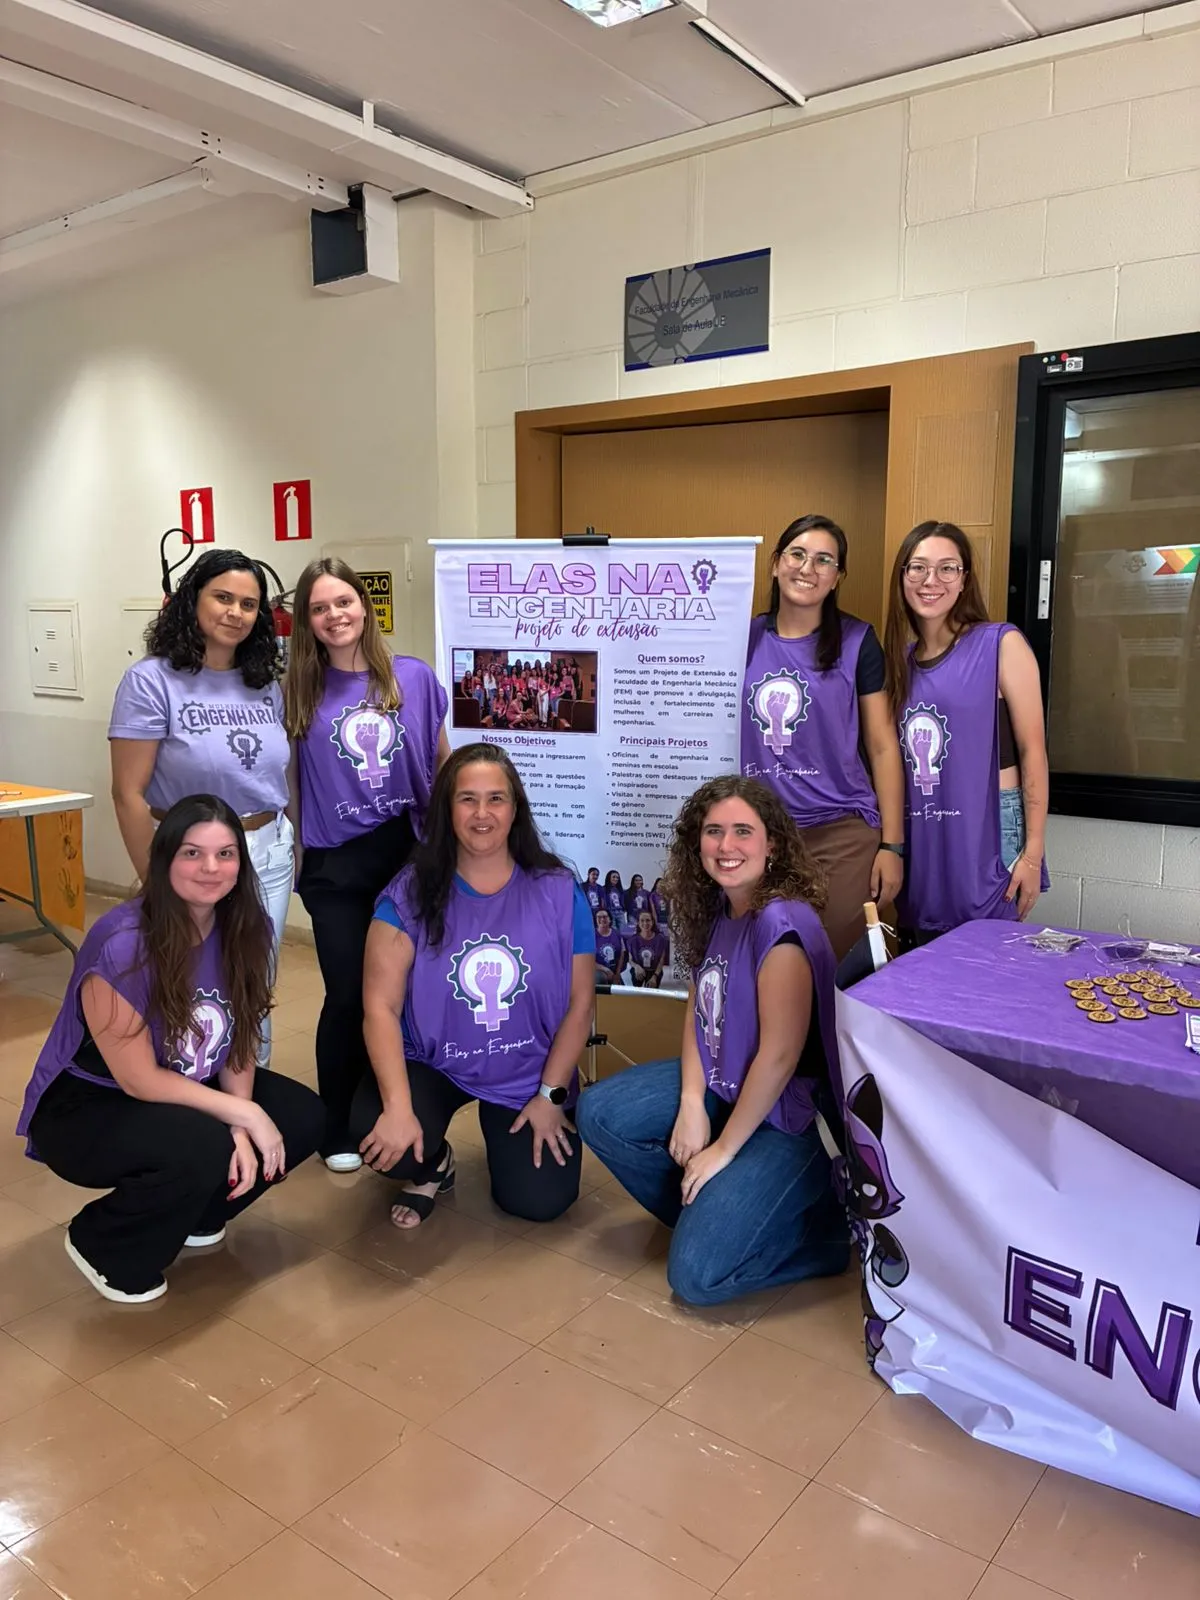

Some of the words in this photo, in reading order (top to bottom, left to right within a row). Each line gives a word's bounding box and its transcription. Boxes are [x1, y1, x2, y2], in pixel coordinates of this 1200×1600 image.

[635, 302, 669, 315] Faculdade
[671, 299, 679, 308] de
[681, 293, 721, 308] Engenharia
[663, 324, 679, 336] Sala
[682, 323, 692, 332] de
[694, 318, 712, 330] Aula
[362, 577, 389, 595] ÇÃO
[468, 563, 596, 595] ELAS
[608, 563, 691, 595] NA
[469, 596, 716, 620] ENGENHARIA
[515, 618, 565, 647] projeto
[571, 614, 590, 637] de
[597, 618, 661, 641] extensão
[638, 654, 666, 664] Quem
[668, 655, 705, 663] somos?
[653, 669, 678, 677] Projeto
[482, 735, 512, 743] Nossos
[515, 736, 556, 746] Objetivos
[620, 736, 665, 747] Principais
[668, 738, 708, 748] Projetos
[556, 773, 585, 781] questões
[1004, 1246, 1200, 1411] EN
